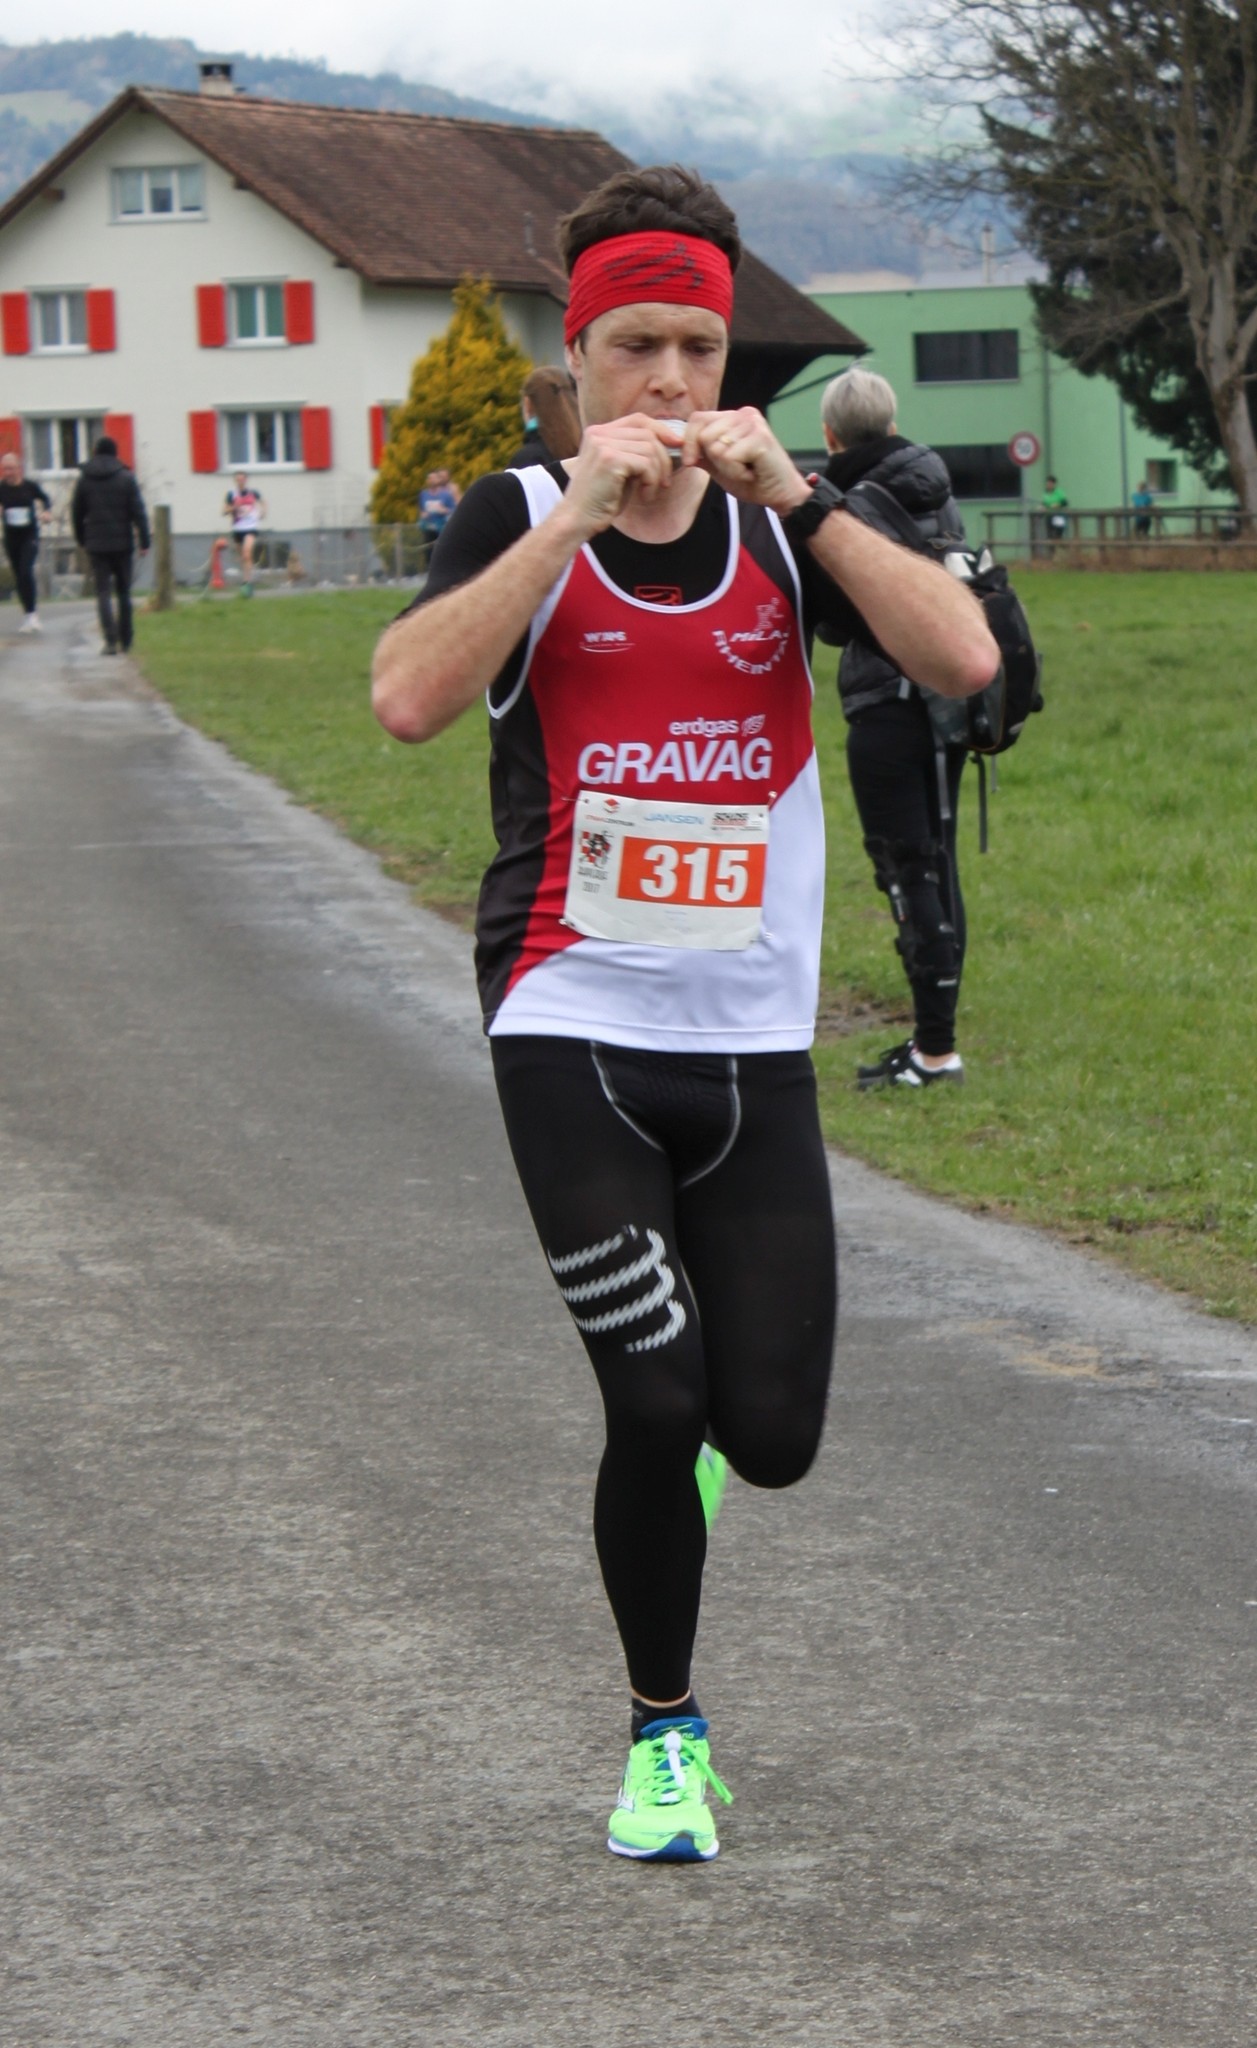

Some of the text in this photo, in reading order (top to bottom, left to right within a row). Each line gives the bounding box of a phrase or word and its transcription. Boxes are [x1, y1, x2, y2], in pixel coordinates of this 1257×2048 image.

[669, 717, 739, 738] erdgas
[577, 736, 773, 785] GRAVAG
[643, 813, 705, 825] JANSEN
[639, 844, 749, 903] 315
